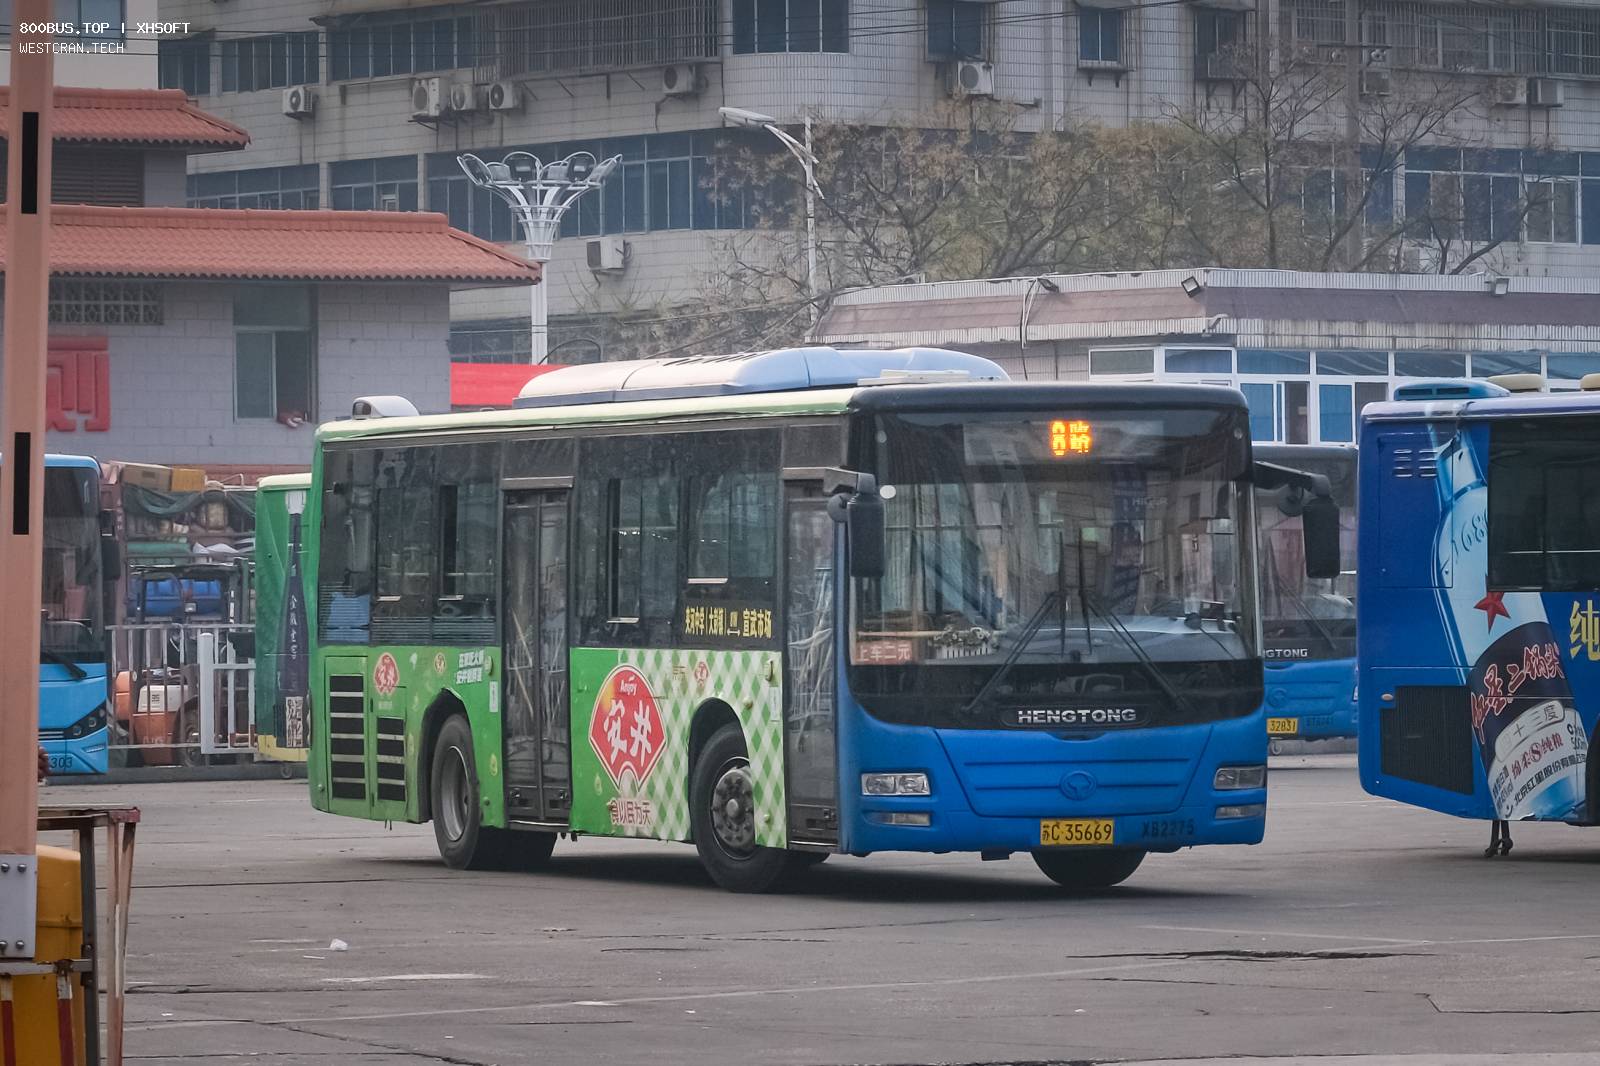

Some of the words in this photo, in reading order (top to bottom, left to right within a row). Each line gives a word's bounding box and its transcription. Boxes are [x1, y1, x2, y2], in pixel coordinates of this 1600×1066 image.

[743, 607, 772, 638] 宣武市场
[859, 642, 911, 662] 上车二元
[1263, 648, 1308, 658] GTONG
[1018, 709, 1137, 723] HENGTONG
